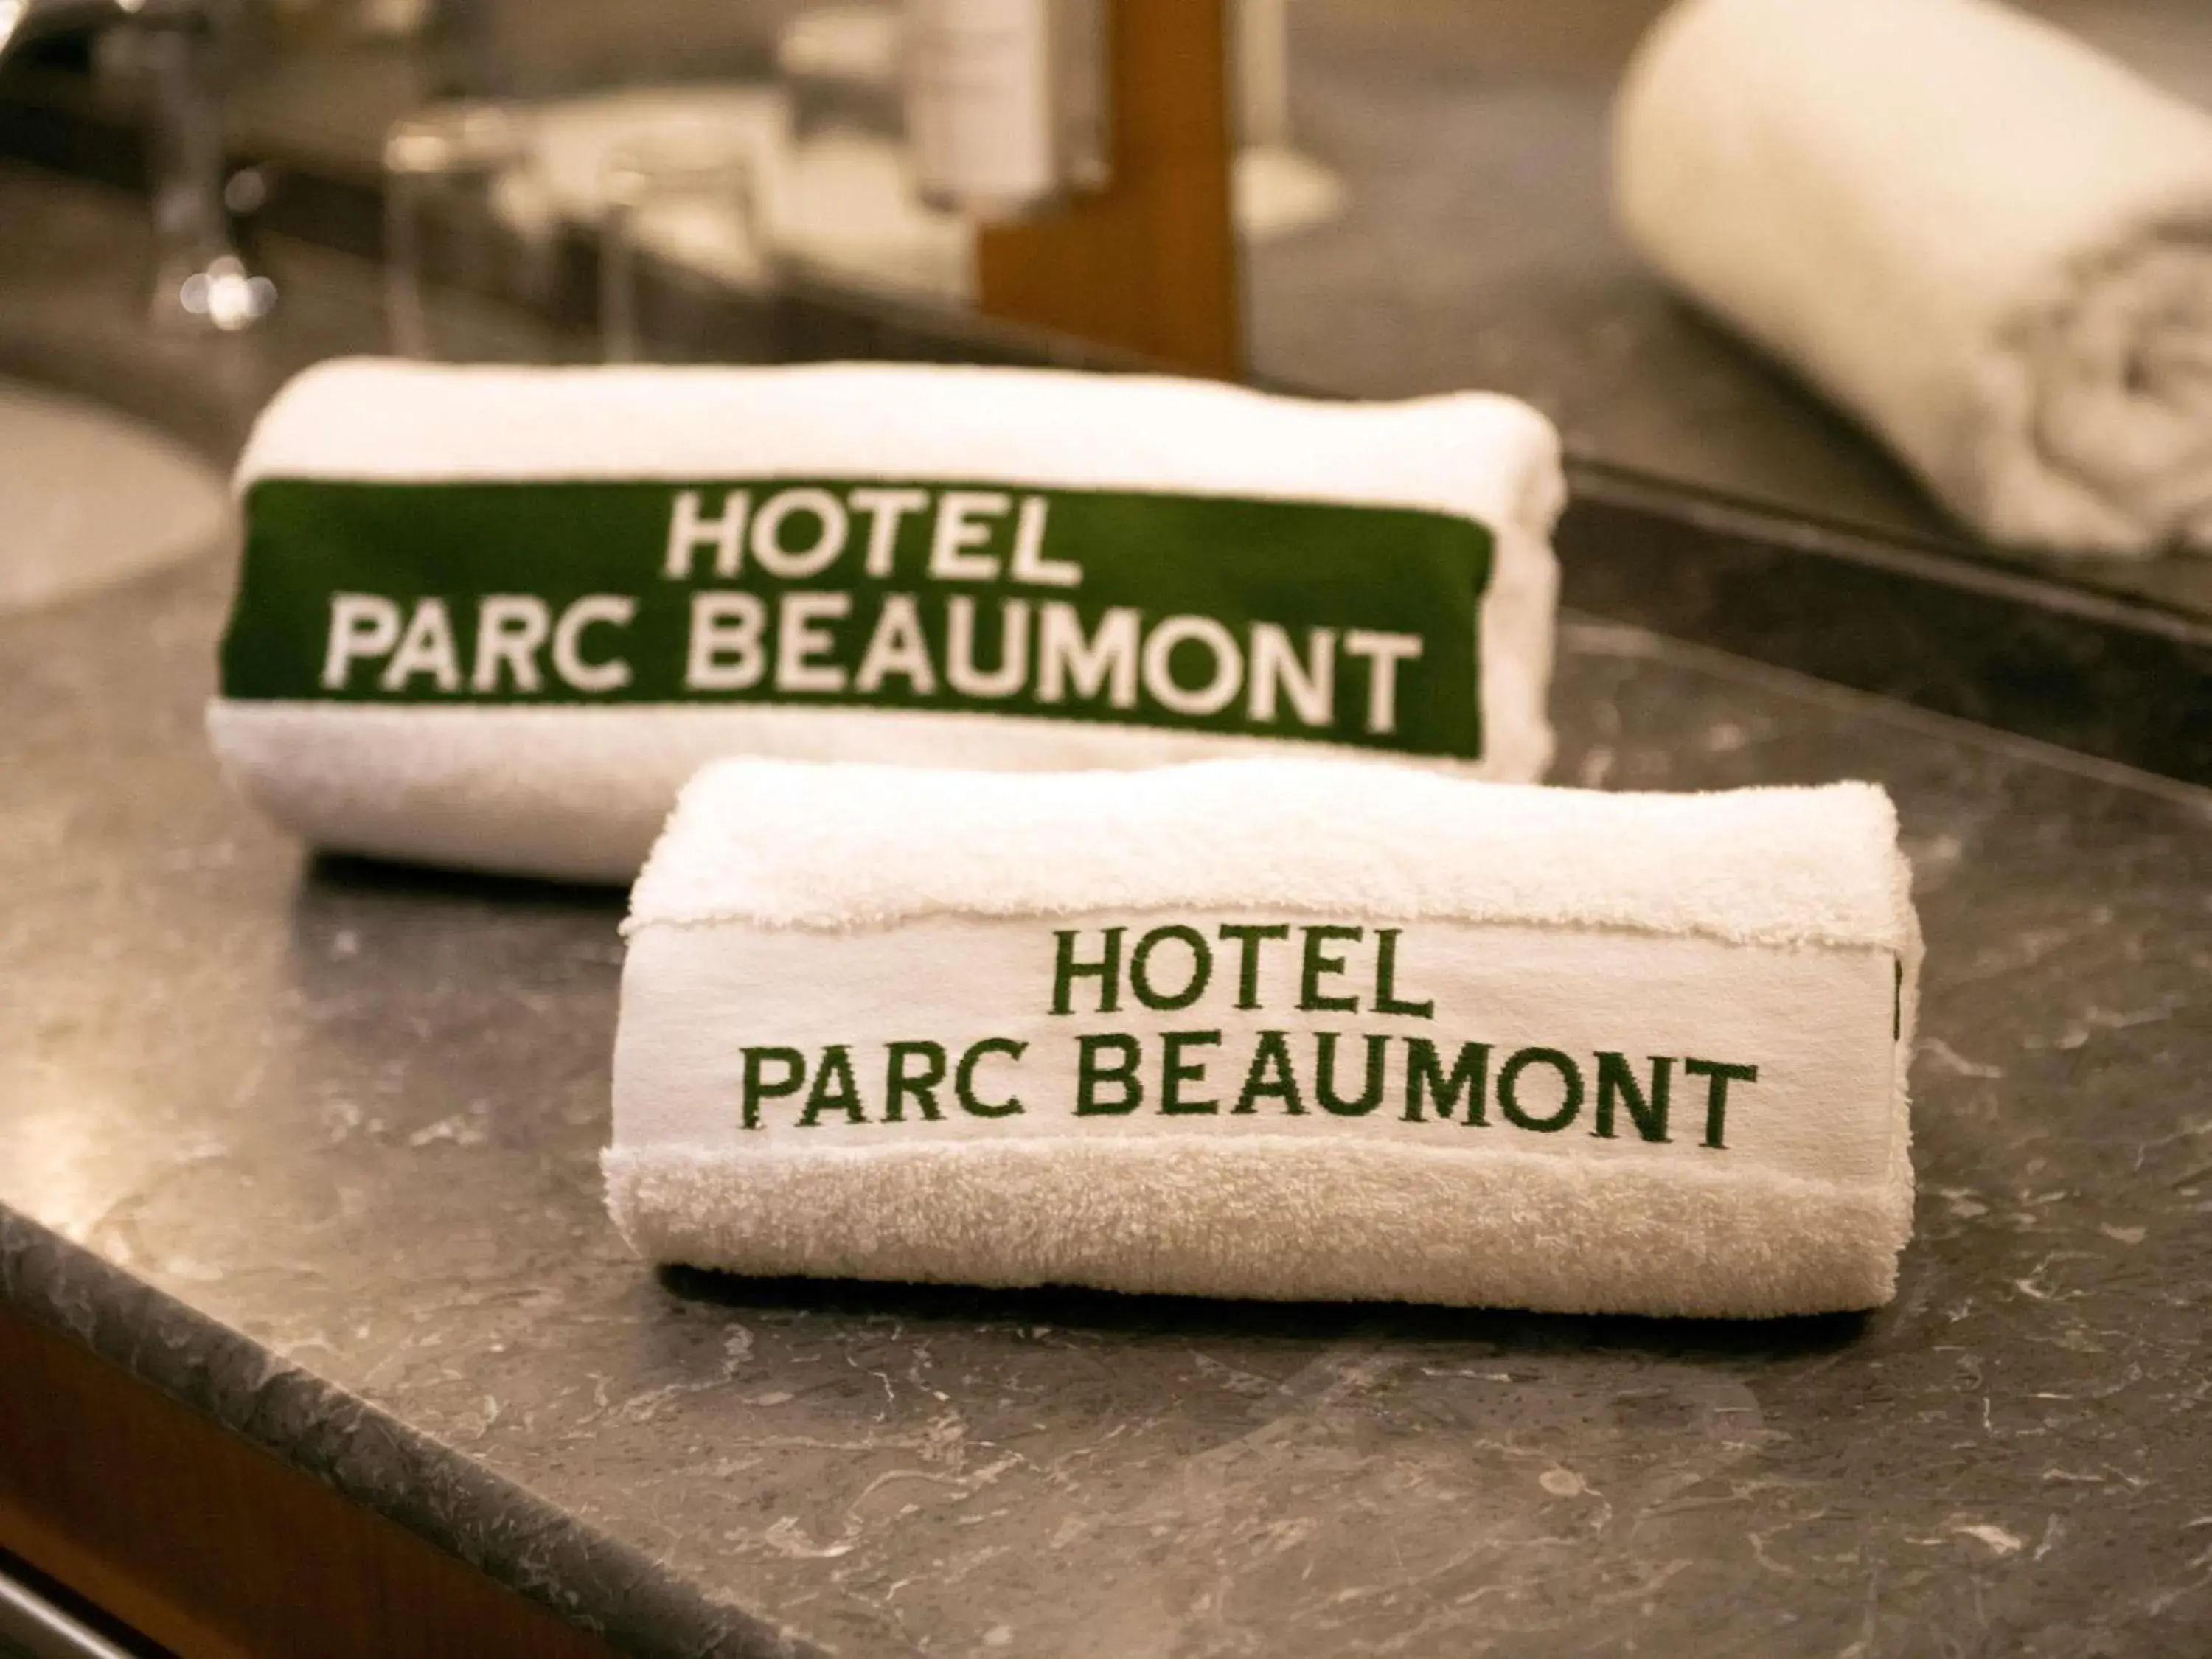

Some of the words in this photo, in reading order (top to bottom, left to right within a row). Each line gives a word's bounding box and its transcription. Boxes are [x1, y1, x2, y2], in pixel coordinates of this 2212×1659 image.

[667, 490, 1080, 585] HOTEL
[325, 594, 631, 690] PARC
[688, 593, 1420, 731] BEAUMONT
[1048, 925, 1433, 1019] HOTEL
[740, 1037, 1029, 1130] PARC
[1071, 1029, 1758, 1150] BEAUMONT
